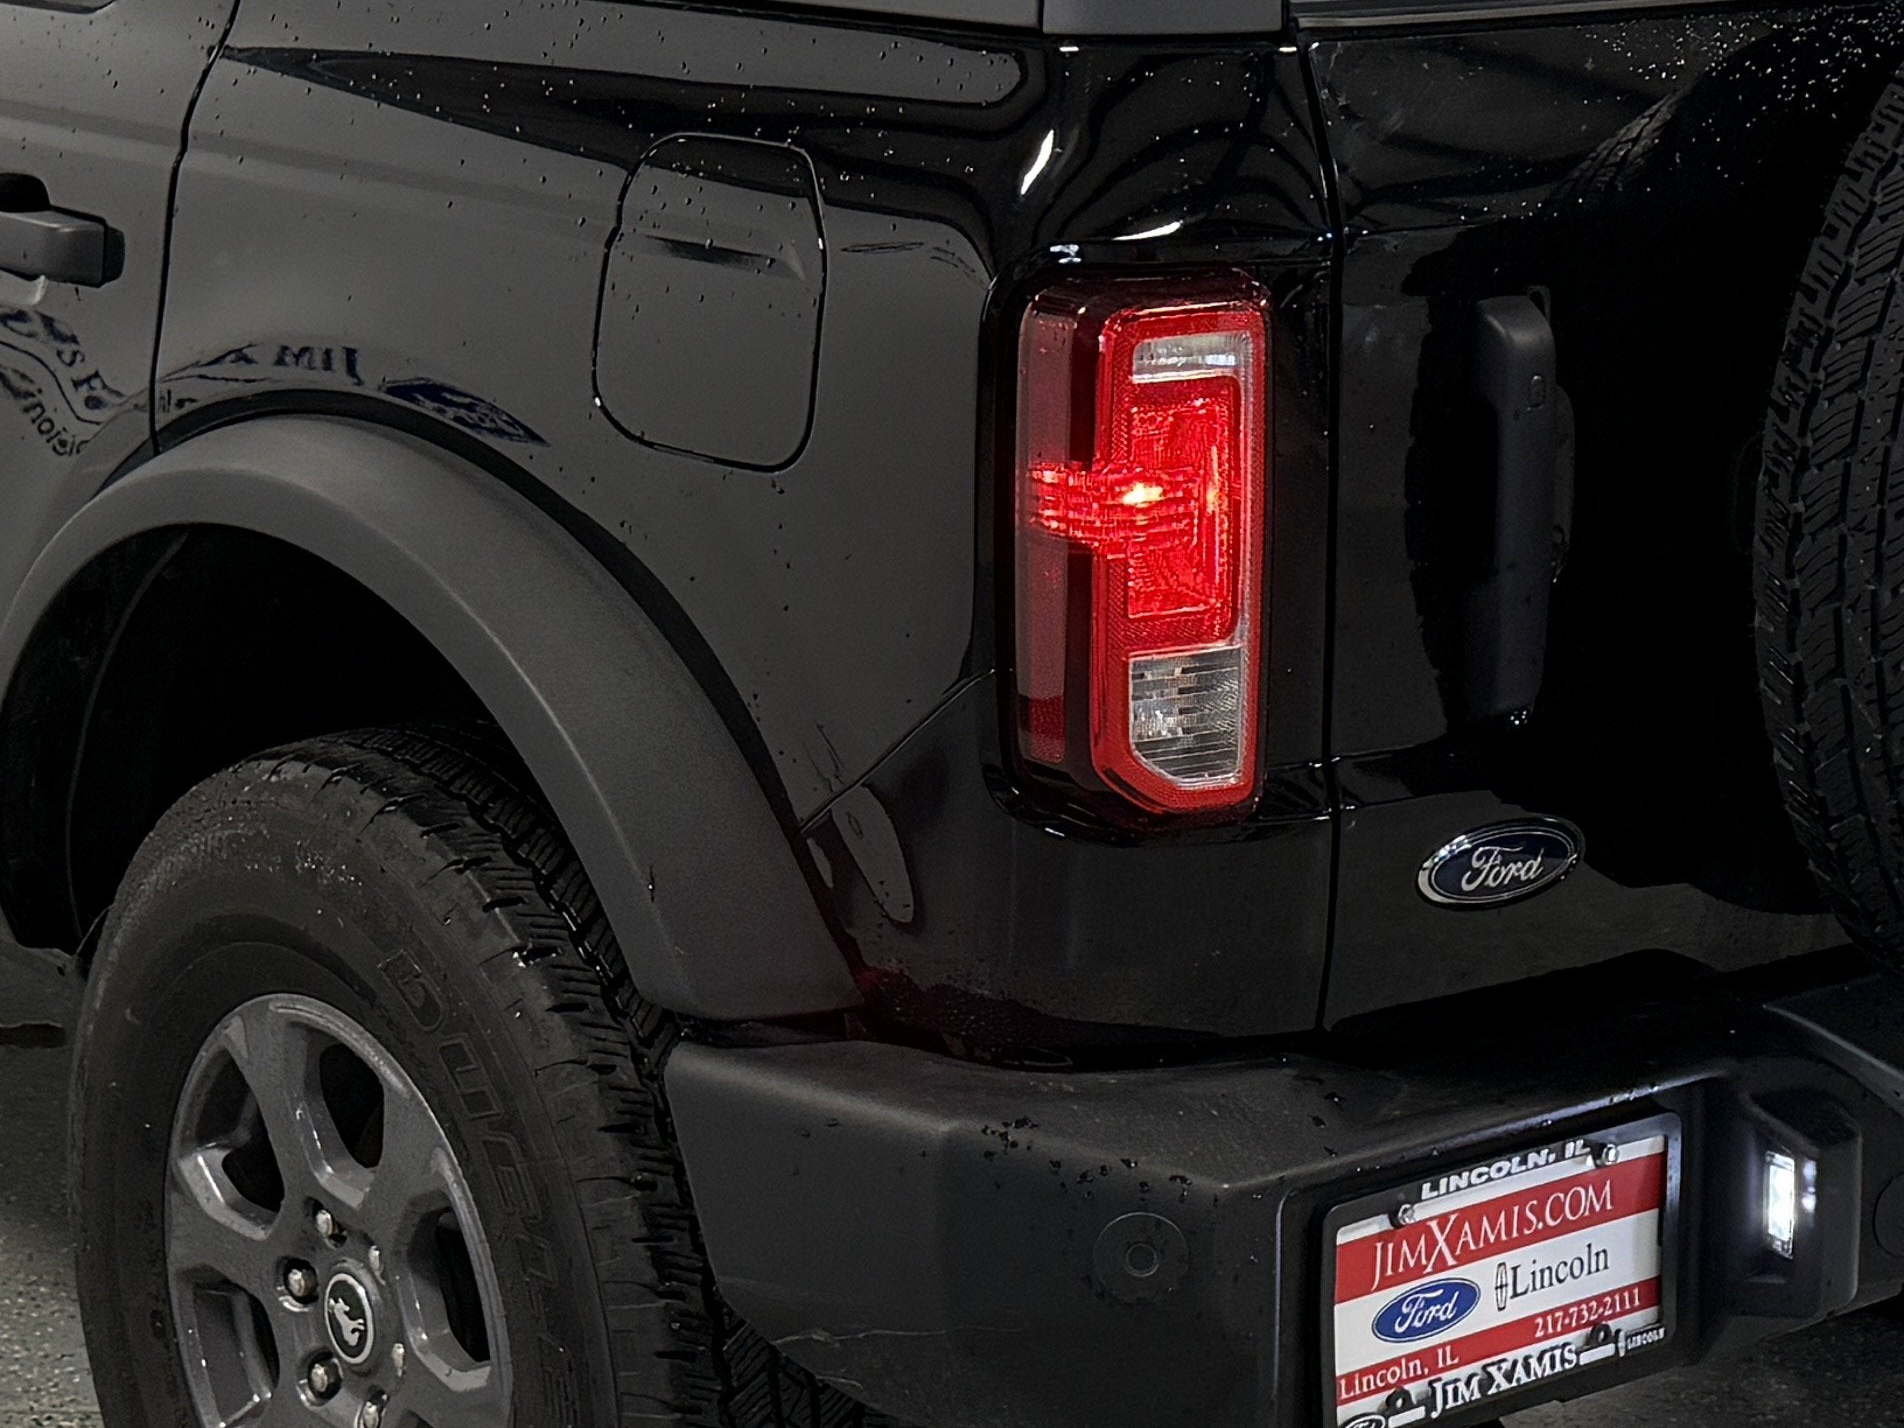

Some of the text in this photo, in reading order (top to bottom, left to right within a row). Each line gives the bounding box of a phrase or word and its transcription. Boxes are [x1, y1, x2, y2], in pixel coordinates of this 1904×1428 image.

[1461, 846, 1544, 891] Ford
[1565, 1139, 1590, 1159] IL
[1371, 1179, 1613, 1292] JIMXAMIS.COM
[1510, 1243, 1610, 1299] Lincoln
[1394, 1289, 1459, 1333] Ford
[1535, 1287, 1640, 1337] 217-732-2111
[1339, 1345, 1459, 1400] Lincoln, IL
[1430, 1343, 1577, 1418] JIM XAMIS
